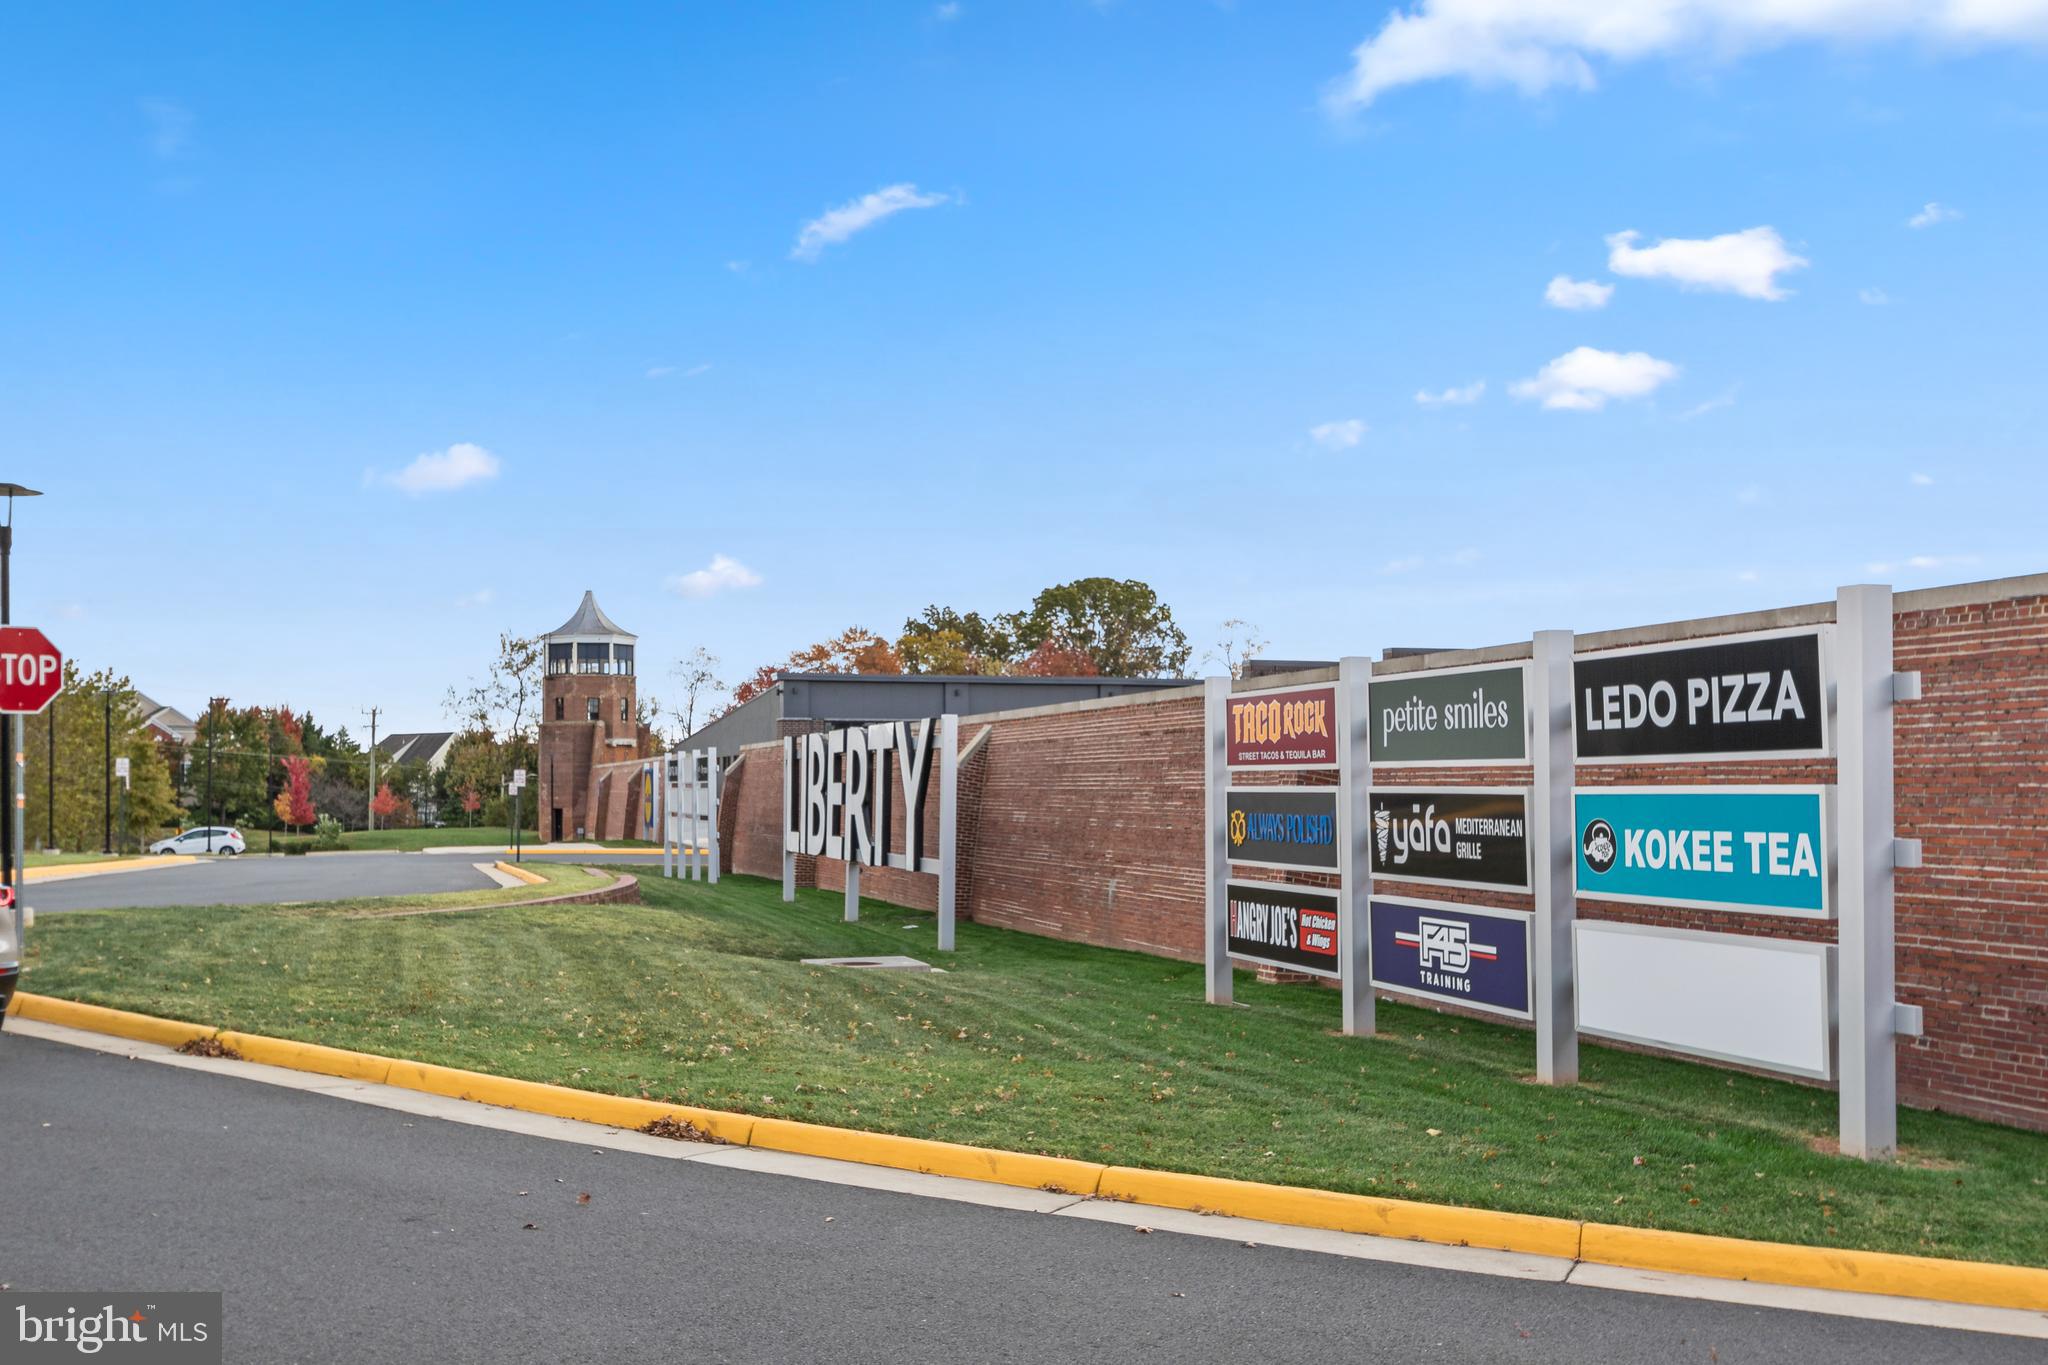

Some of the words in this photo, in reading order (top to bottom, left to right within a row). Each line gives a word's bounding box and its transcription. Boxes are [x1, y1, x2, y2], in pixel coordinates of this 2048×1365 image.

[0, 653, 57, 686] TOP
[1383, 695, 1438, 748] petite
[1444, 687, 1509, 731] smiles
[1585, 680, 1677, 731] LEDO
[1687, 669, 1806, 726] PIZZA
[1232, 699, 1281, 745] TACO
[1283, 699, 1329, 740] ROCK
[1238, 751, 1259, 761] STREET
[1260, 750, 1279, 760] TACOS
[1280, 750, 1285, 760] &
[1285, 749, 1311, 760] TEQUILA
[1312, 749, 1326, 759] BAR
[784, 717, 936, 872] LIBERTY
[1247, 812, 1286, 843] ALWAYS
[1455, 817, 1523, 838] MEDITERRANEAN
[1456, 841, 1482, 860] GRILLE
[1624, 828, 1734, 873] KOKEE
[1743, 831, 1819, 878] TEA
[1230, 899, 1269, 944] HANGRY
[1269, 905, 1298, 949] JOE'S
[1419, 970, 1471, 993] TRAINING
